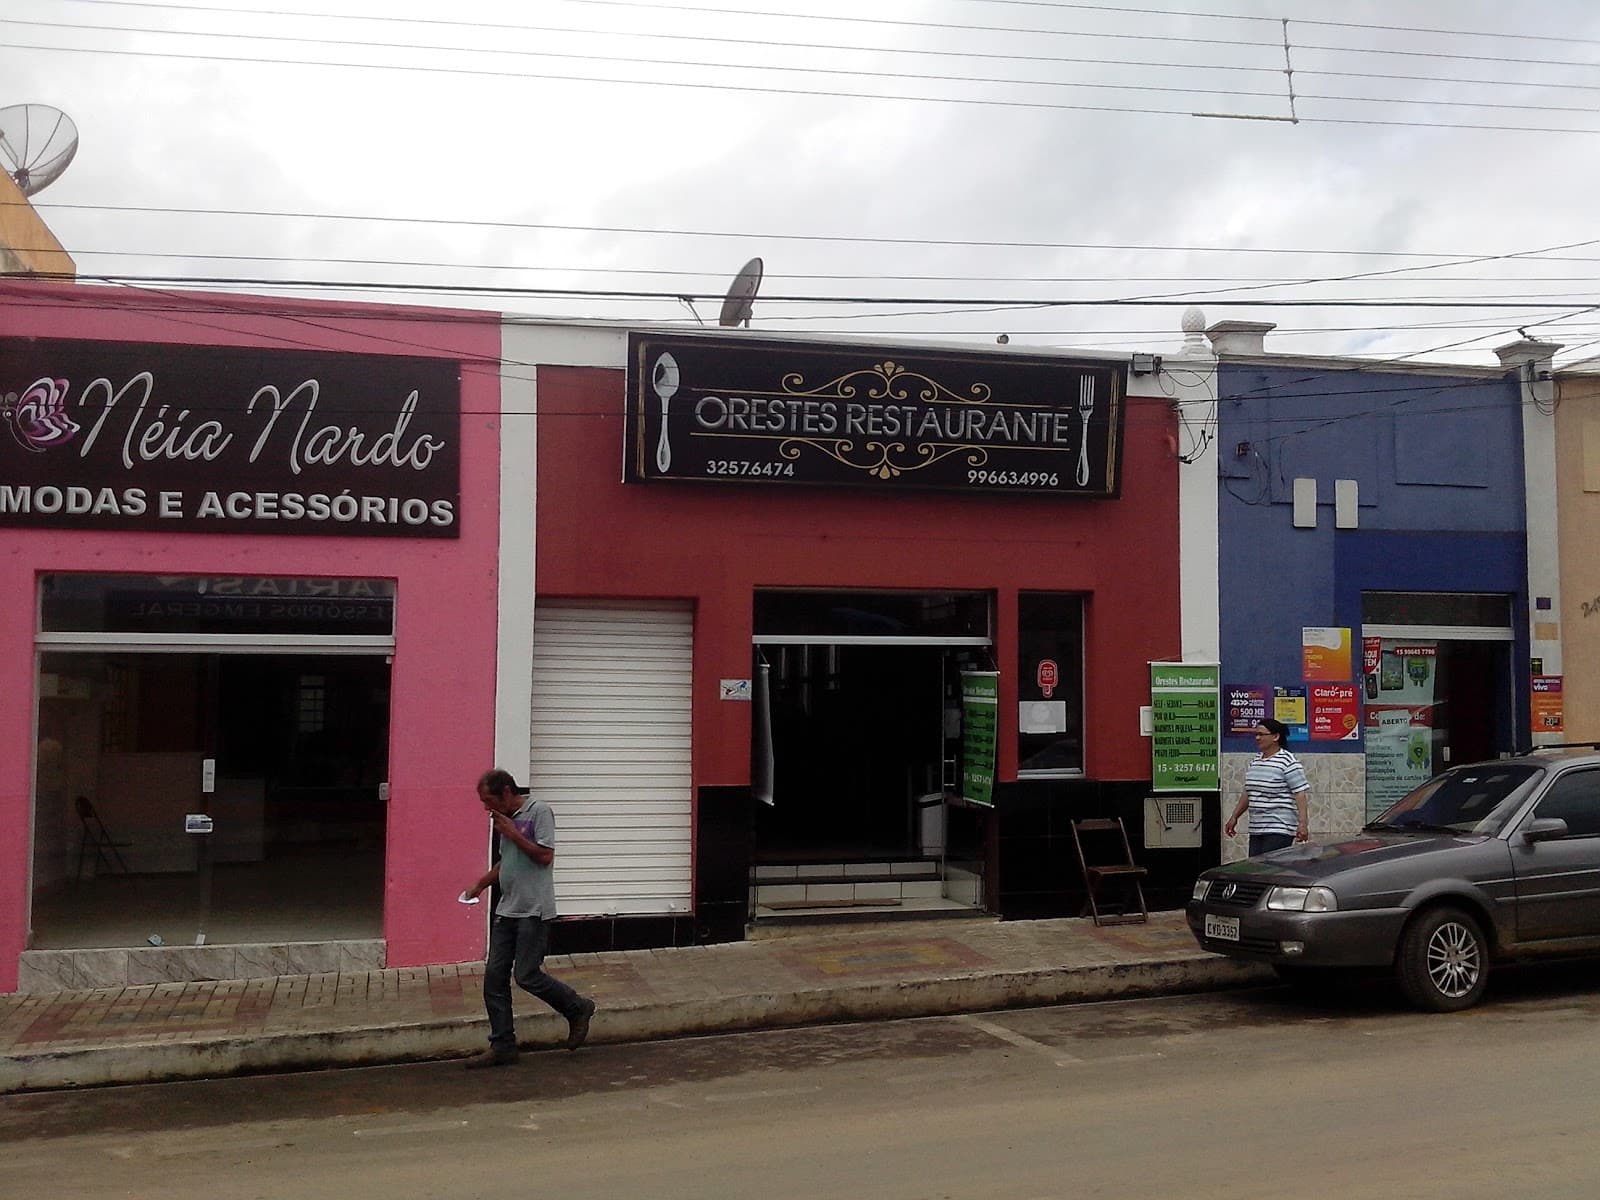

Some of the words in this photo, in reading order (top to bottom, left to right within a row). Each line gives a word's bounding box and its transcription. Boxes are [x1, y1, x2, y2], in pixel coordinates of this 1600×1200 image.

[78, 371, 233, 469] Néia
[247, 379, 445, 474] Nardo
[695, 396, 839, 435] ORESTES
[845, 401, 1069, 443] RESTAURANTE
[706, 460, 795, 478] 3257.6474
[967, 469, 1060, 487] 99663.4996
[0, 485, 147, 516] MODAS
[159, 491, 183, 518] E
[197, 488, 455, 526] ACESSÓRIOS
[1230, 690, 1249, 699] vivo
[1314, 688, 1336, 697] Claro
[1339, 688, 1353, 698] pré
[1157, 763, 1168, 773] 15
[1174, 763, 1193, 773] 3257
[1195, 763, 1216, 773] 6474
